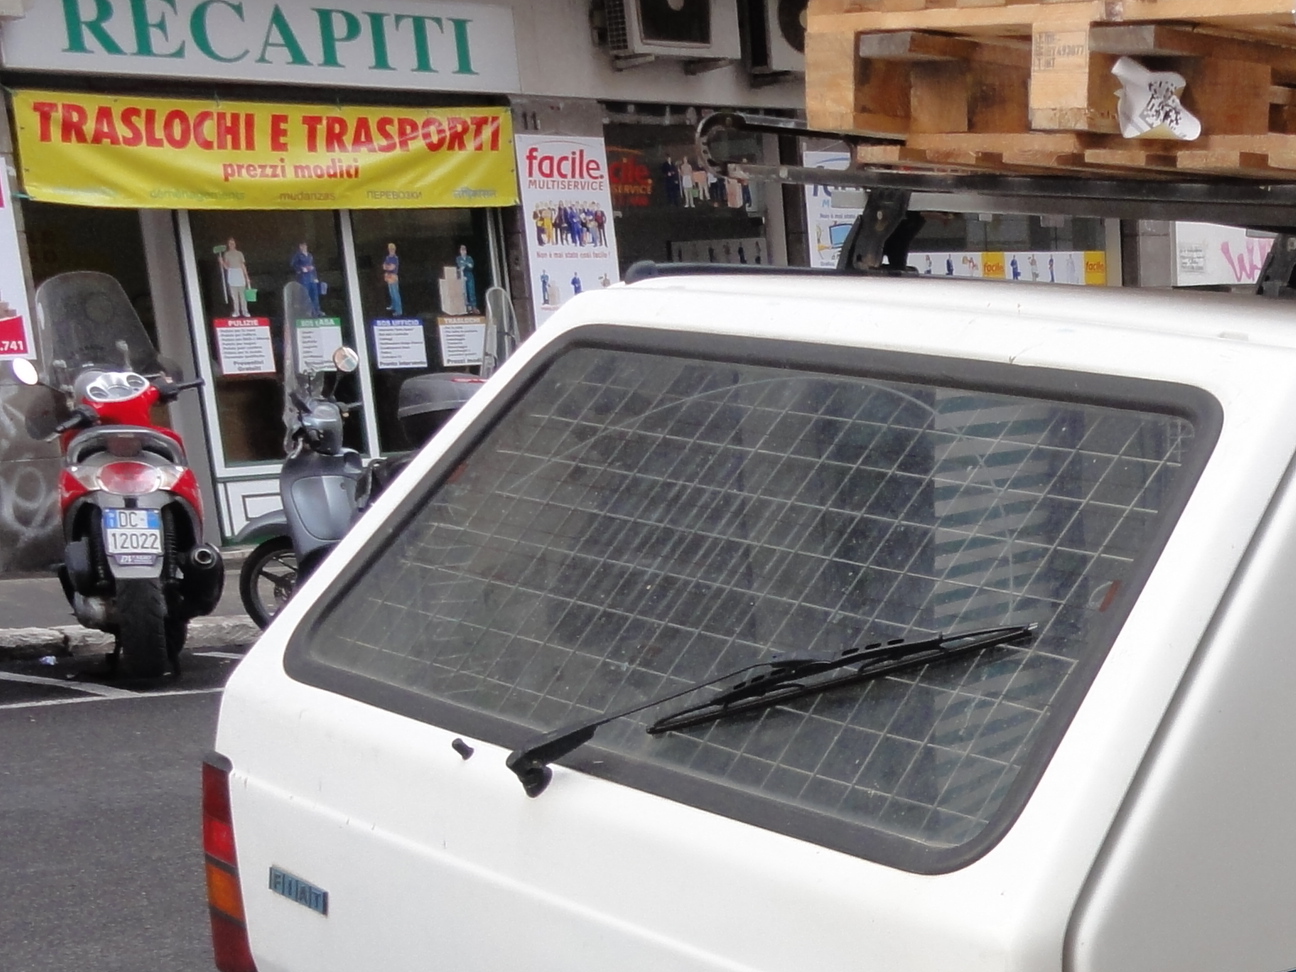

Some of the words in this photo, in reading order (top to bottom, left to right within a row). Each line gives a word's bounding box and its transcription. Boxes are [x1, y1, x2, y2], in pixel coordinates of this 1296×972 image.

[62, 0, 480, 76] RECAPITI
[32, 101, 256, 152] TRASLOCHI
[270, 116, 289, 153] E
[302, 116, 501, 153] TRASPORTI
[222, 157, 287, 182] prezzi
[293, 159, 360, 180] modici
[528, 180, 604, 191] MULTISERVICE
[279, 191, 337, 201] mudanzas
[366, 190, 423, 200] ПЕРЕВОЗКИ
[118, 511, 138, 528] DC
[111, 533, 160, 550] 12022
[268, 866, 328, 917] FIAT
